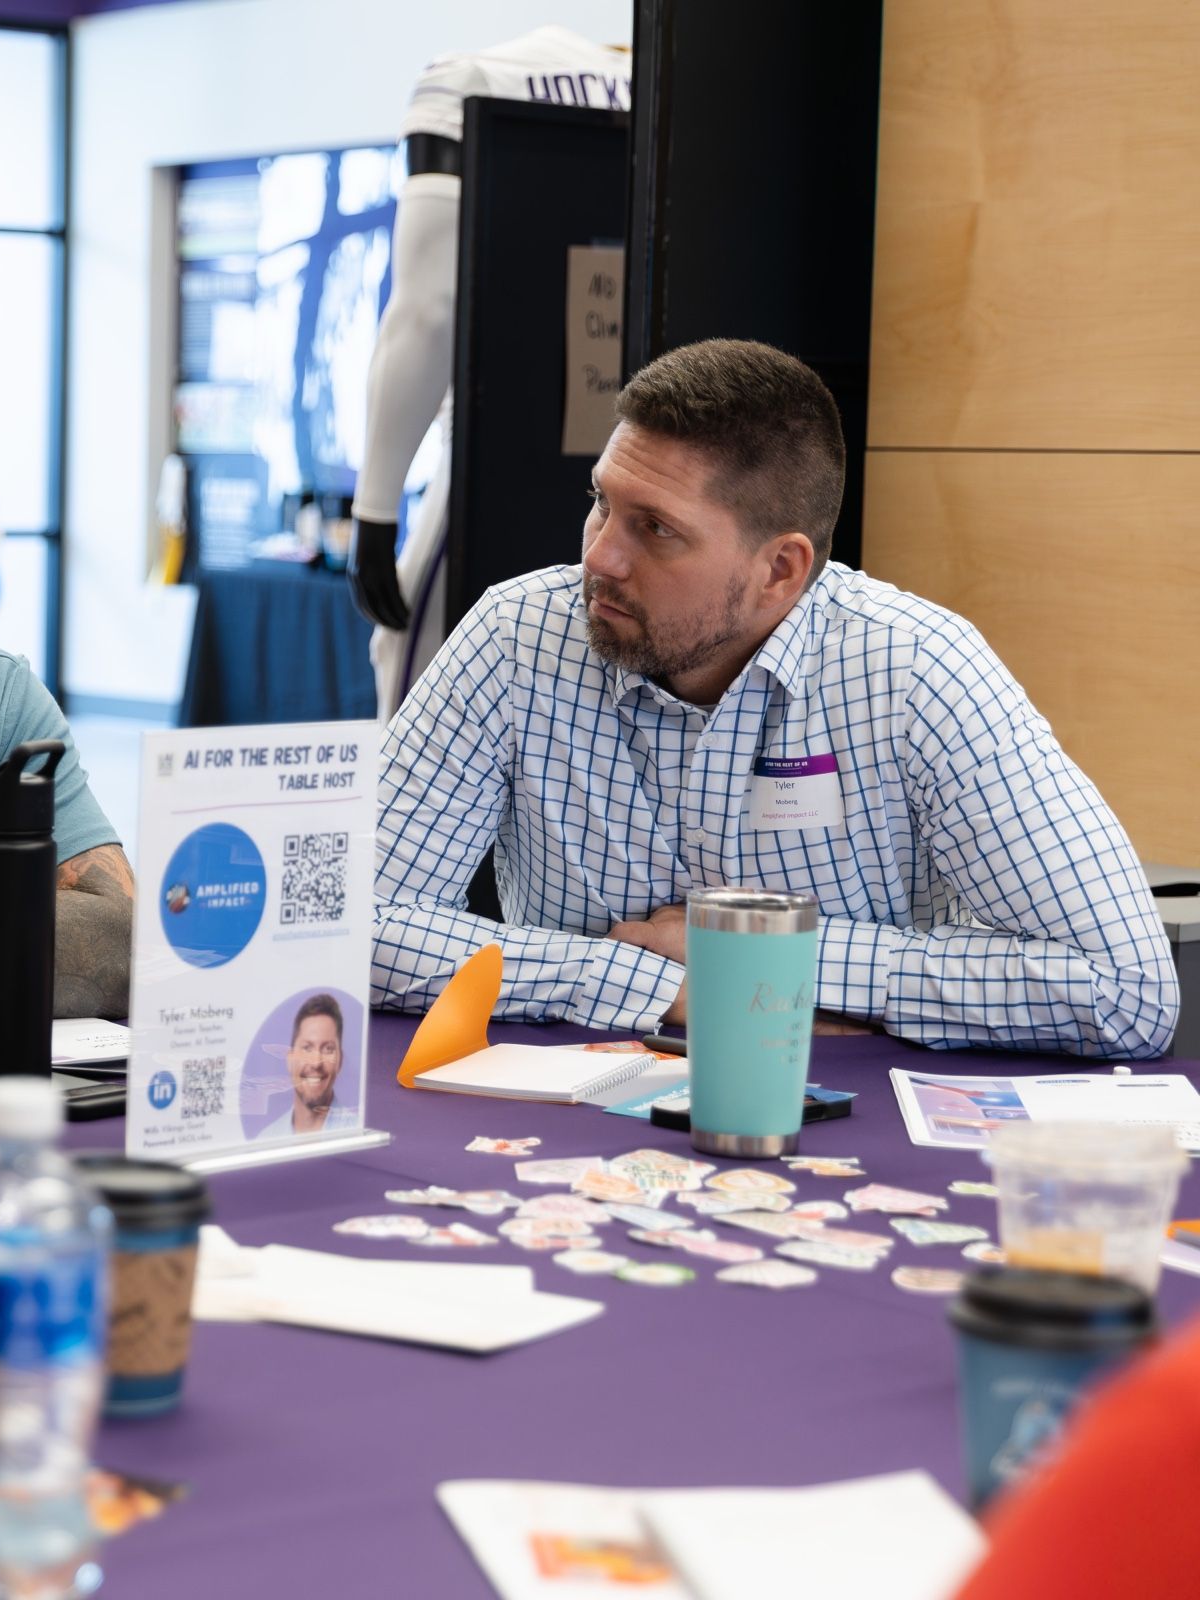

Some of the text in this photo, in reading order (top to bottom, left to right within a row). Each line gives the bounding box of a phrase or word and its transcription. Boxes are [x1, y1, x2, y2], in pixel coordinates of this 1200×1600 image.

[527, 72, 632, 110] HOCK
[184, 750, 200, 769] AI
[204, 749, 233, 768] FOR
[240, 747, 268, 767] THE
[273, 745, 311, 765] REST
[316, 744, 335, 763] OF
[339, 744, 358, 763] US
[278, 772, 355, 791] TABLE HOST
[774, 781, 796, 791] Tyler
[196, 881, 260, 898] AMPLIFIED
[207, 896, 246, 908] IMPACT
[159, 1003, 234, 1025] Tyler Moberg
[153, 1072, 172, 1101] in
